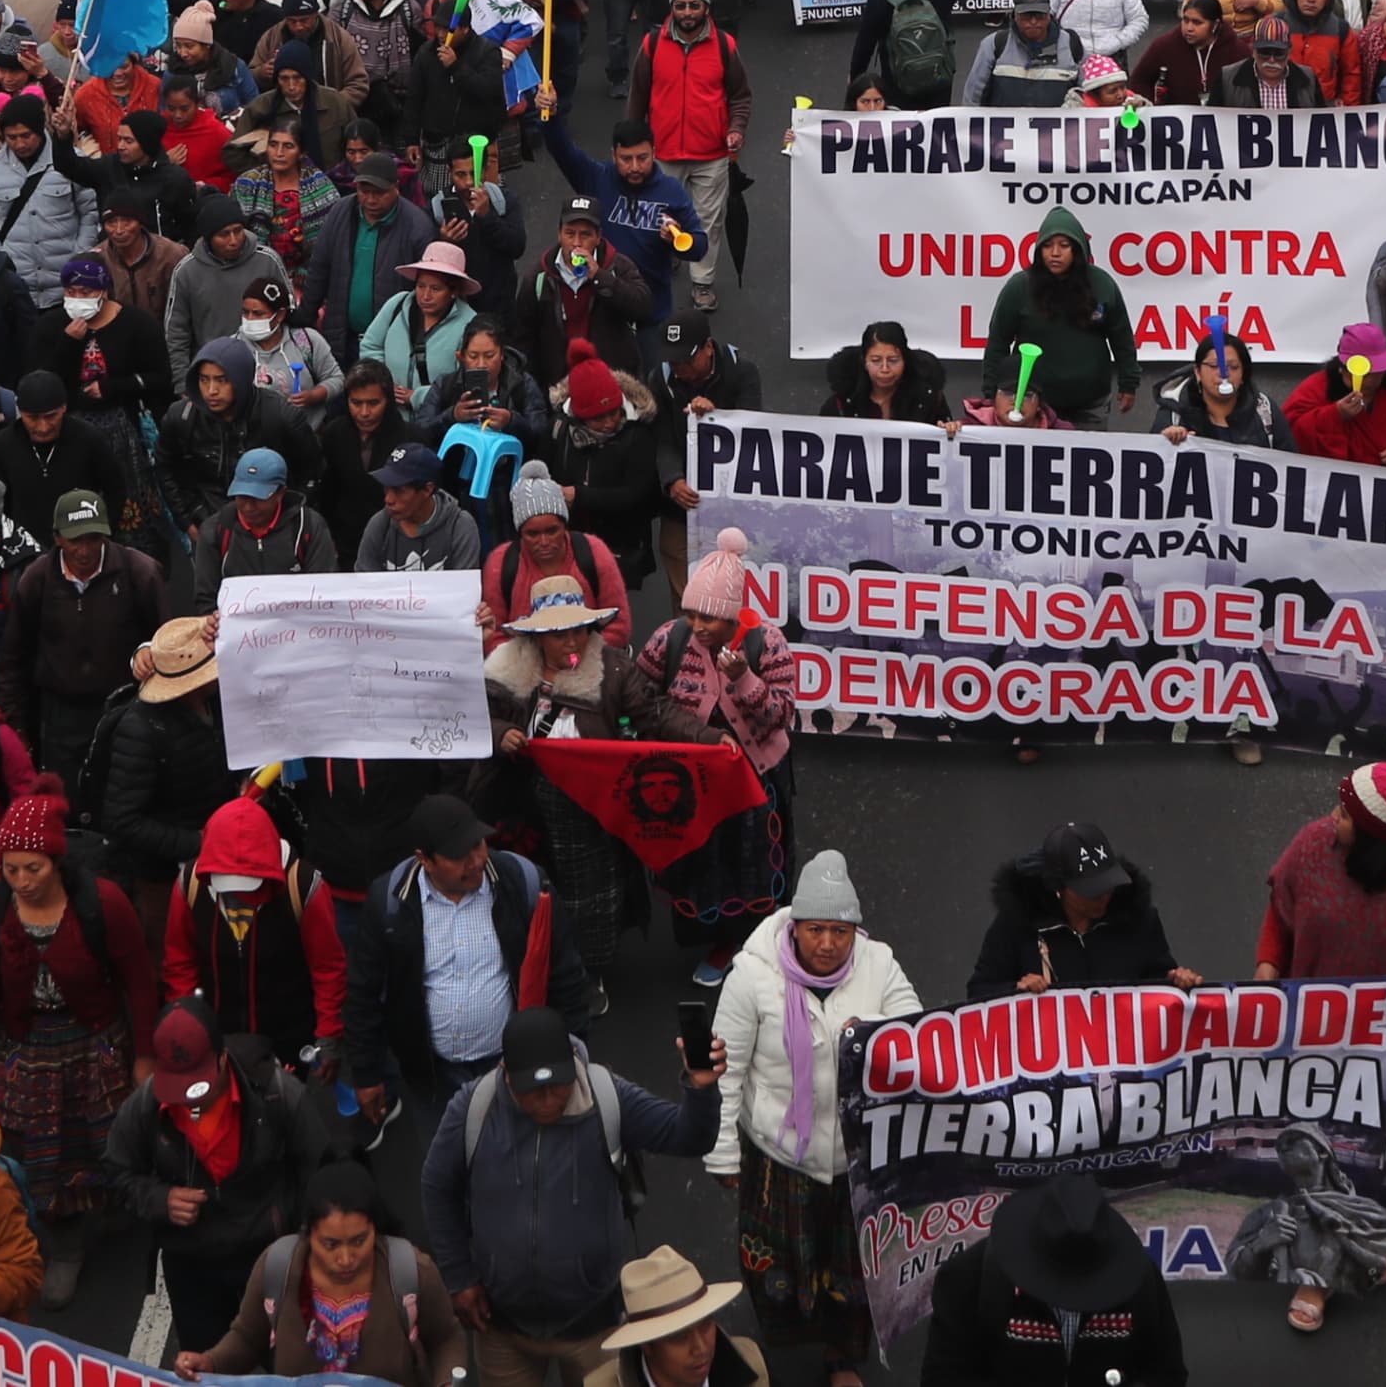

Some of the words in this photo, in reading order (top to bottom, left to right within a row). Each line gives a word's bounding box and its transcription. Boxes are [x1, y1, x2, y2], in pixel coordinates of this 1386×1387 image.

[802, 5, 862, 21] ENUNCIEN
[820, 117, 1014, 175] PARAJE
[1029, 114, 1225, 173] TIERRA
[1002, 174, 1252, 206] TOTONICAPÁN
[878, 230, 1095, 277] UNID
[1108, 229, 1347, 278] CONTRA
[960, 306, 991, 348] L
[697, 423, 941, 507] PARAJE
[960, 441, 1212, 520] TIERRA
[924, 517, 1248, 564] TOTONICAPÁN
[348, 580, 427, 621] presente
[743, 571, 780, 618] N
[808, 574, 1142, 642] DEFENSA
[1163, 591, 1258, 641] DE
[1284, 601, 1374, 657] LA
[237, 629, 297, 655] Afuera
[309, 623, 397, 646] corruptos
[794, 657, 1275, 721] DEMOCRACIA
[868, 990, 1284, 1094] COMUNIDAD
[1299, 986, 1386, 1046] DE
[863, 1085, 1100, 1170] TIERRA
[1119, 1057, 1381, 1147] BLANCA
[994, 1130, 1214, 1177] TOTONICAPÁN
[897, 1254, 929, 1290] EN
